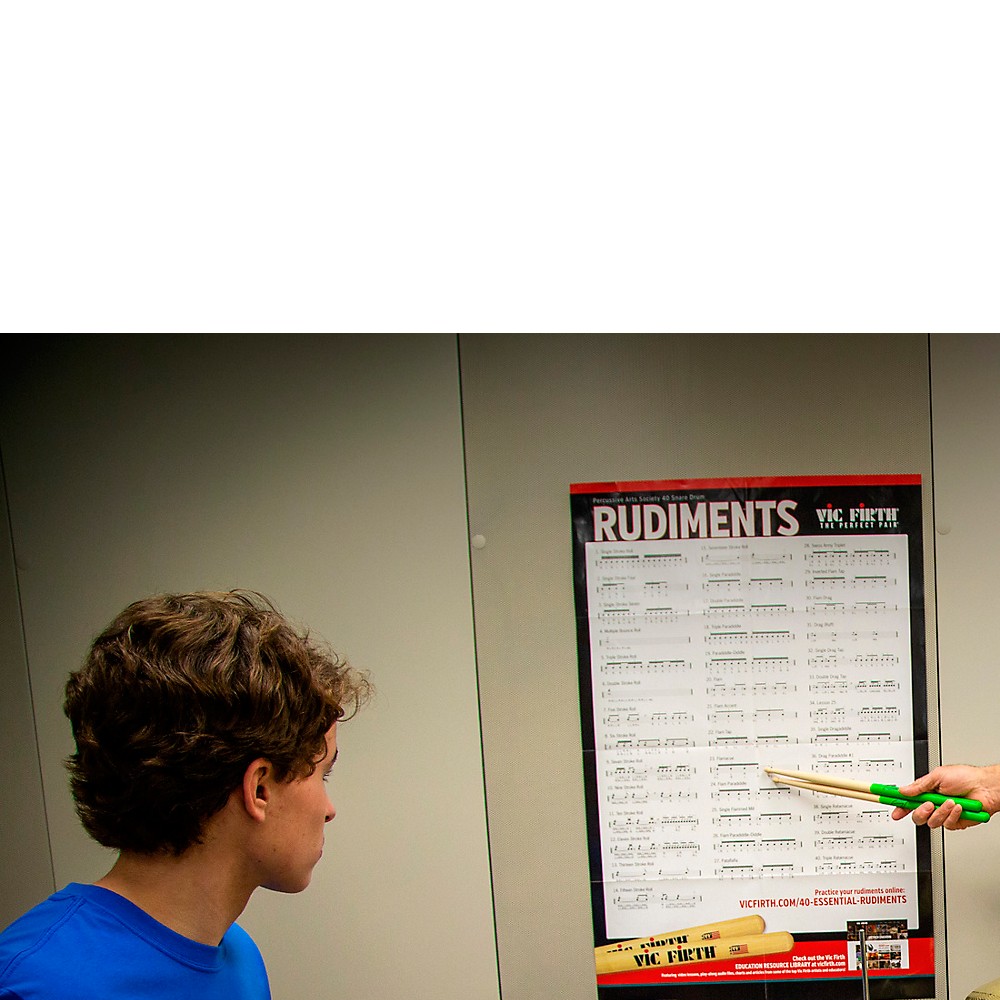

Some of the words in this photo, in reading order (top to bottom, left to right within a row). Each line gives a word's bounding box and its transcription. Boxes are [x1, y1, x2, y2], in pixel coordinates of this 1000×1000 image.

[593, 500, 799, 541] RUDIMENTS
[816, 503, 843, 522] VIC
[850, 503, 897, 521] FIRTH
[739, 895, 907, 908] VICFIRTH.COM/40-ESSENTIAL-RUDIMENTS
[633, 949, 660, 967] VIC
[667, 945, 716, 963] FIRTH
